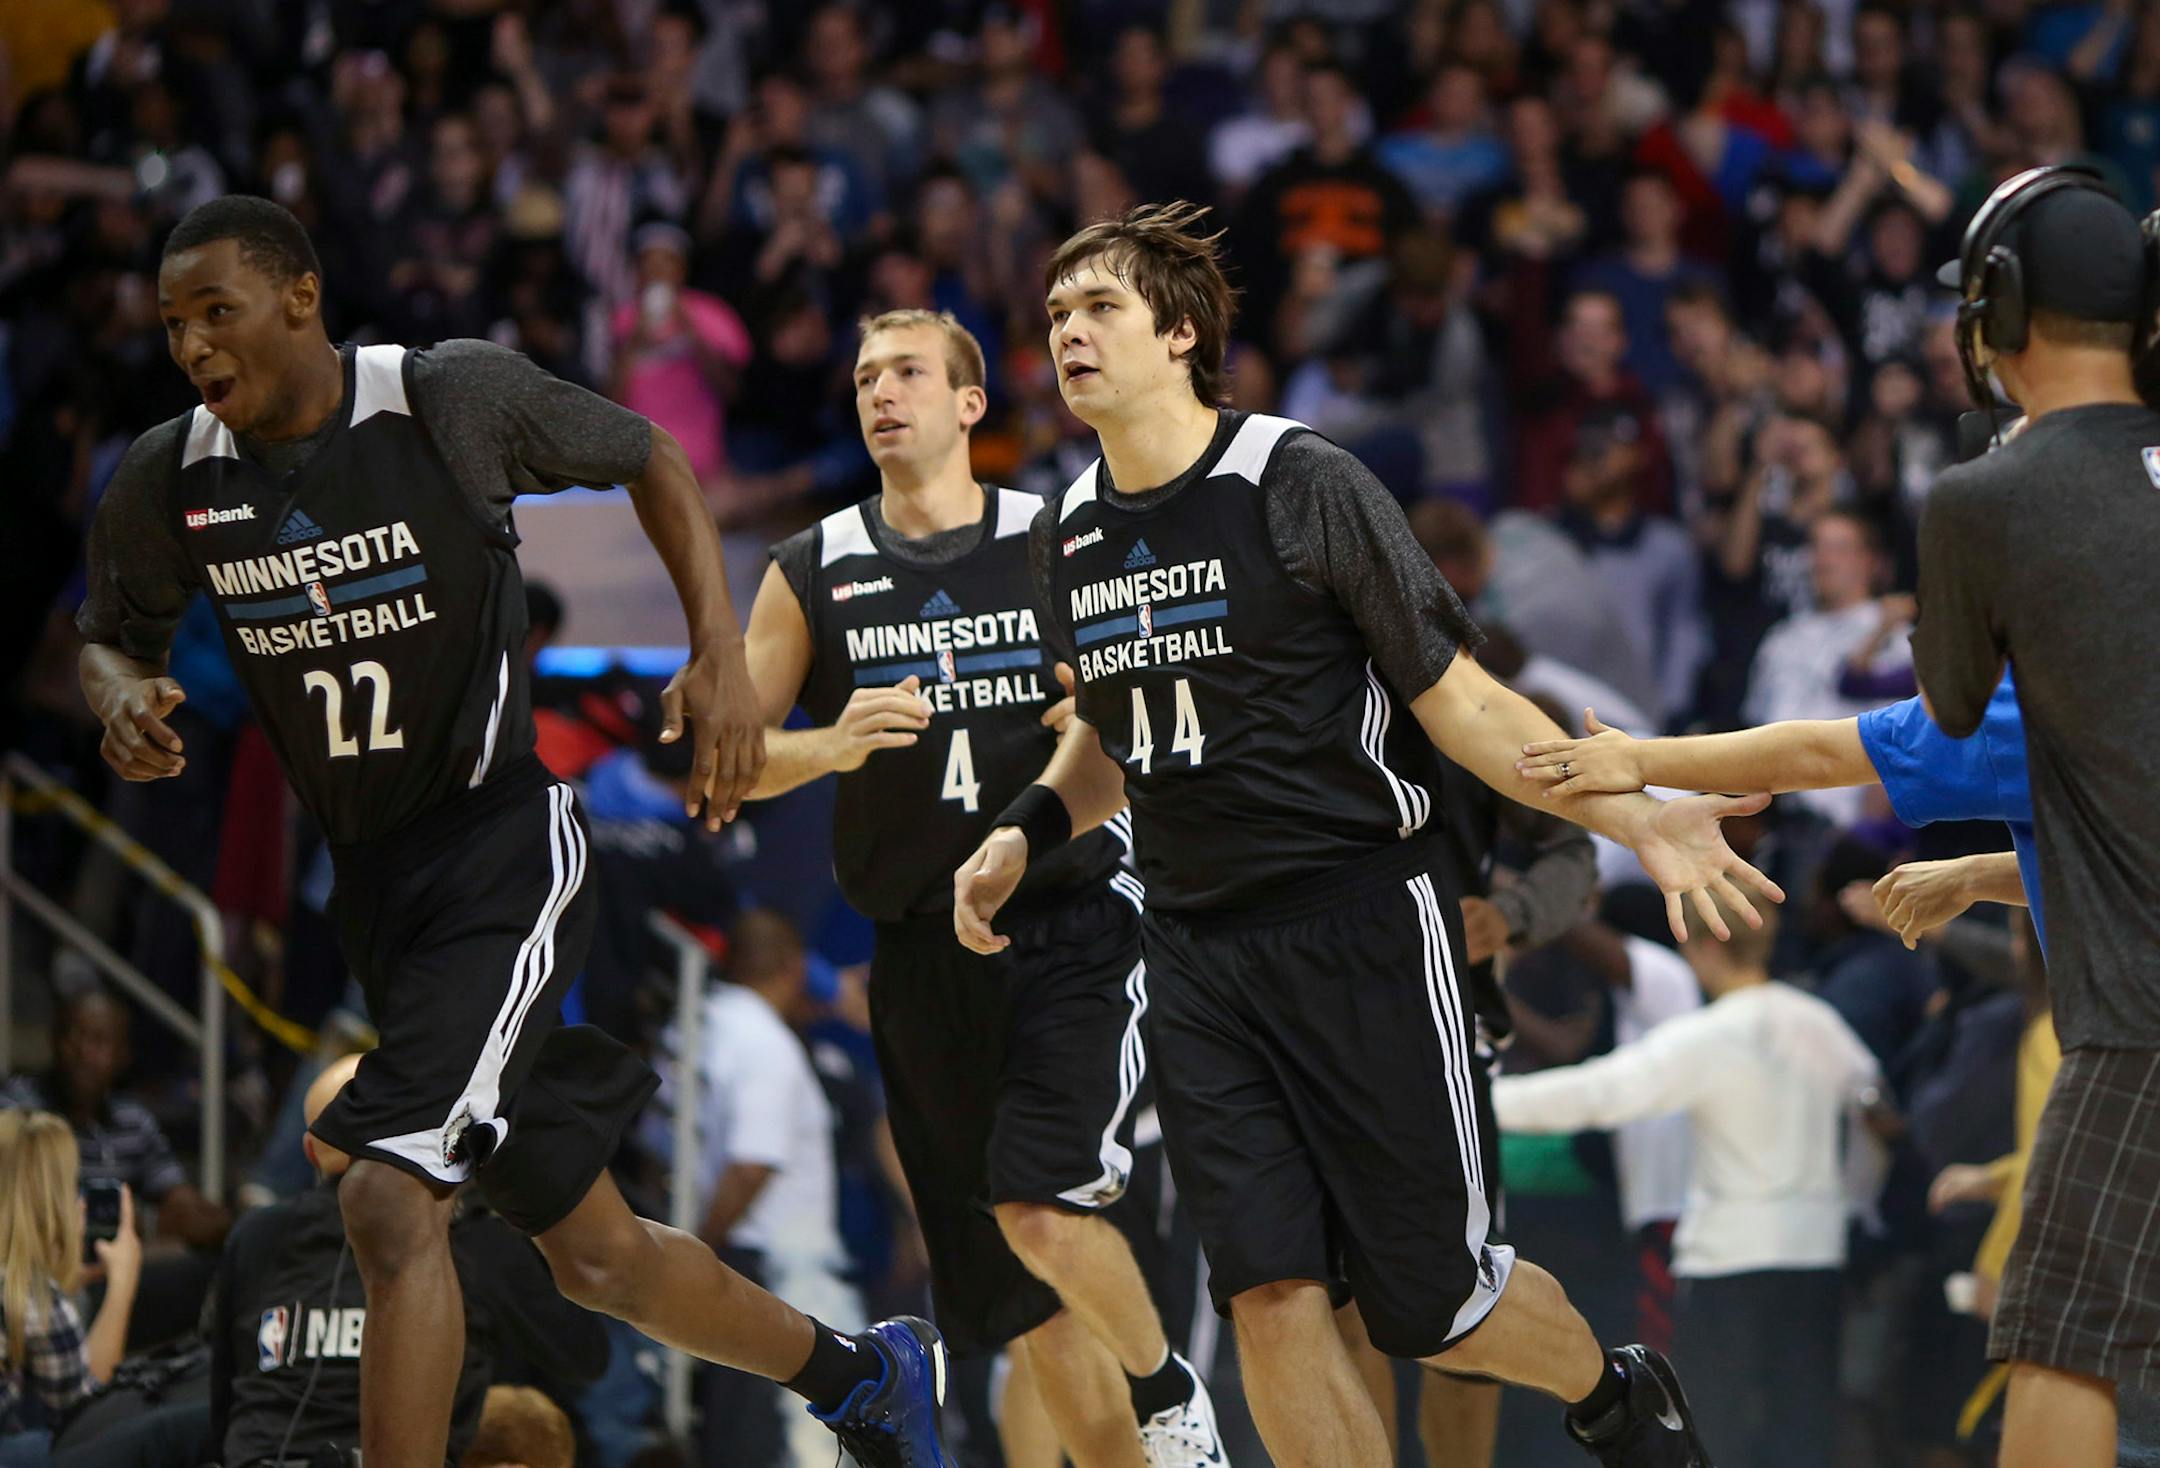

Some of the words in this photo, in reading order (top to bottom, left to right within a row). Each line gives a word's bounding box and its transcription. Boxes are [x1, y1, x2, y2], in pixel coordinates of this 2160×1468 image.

[186, 503, 257, 528] usbank
[277, 526, 324, 545] adidas
[206, 521, 421, 596] MINNESOTA
[1123, 554, 1157, 570] adidas
[1070, 558, 1226, 622] MINNESOTA
[236, 593, 437, 657] BASKETBALL
[845, 608, 1040, 662] MINNESOTA
[1079, 626, 1233, 683] BASKETBALL
[302, 660, 404, 758] 22
[913, 673, 1046, 713] KETBALL
[1125, 678, 1206, 775] 44
[941, 728, 981, 812] 4
[305, 1307, 366, 1358] NB
